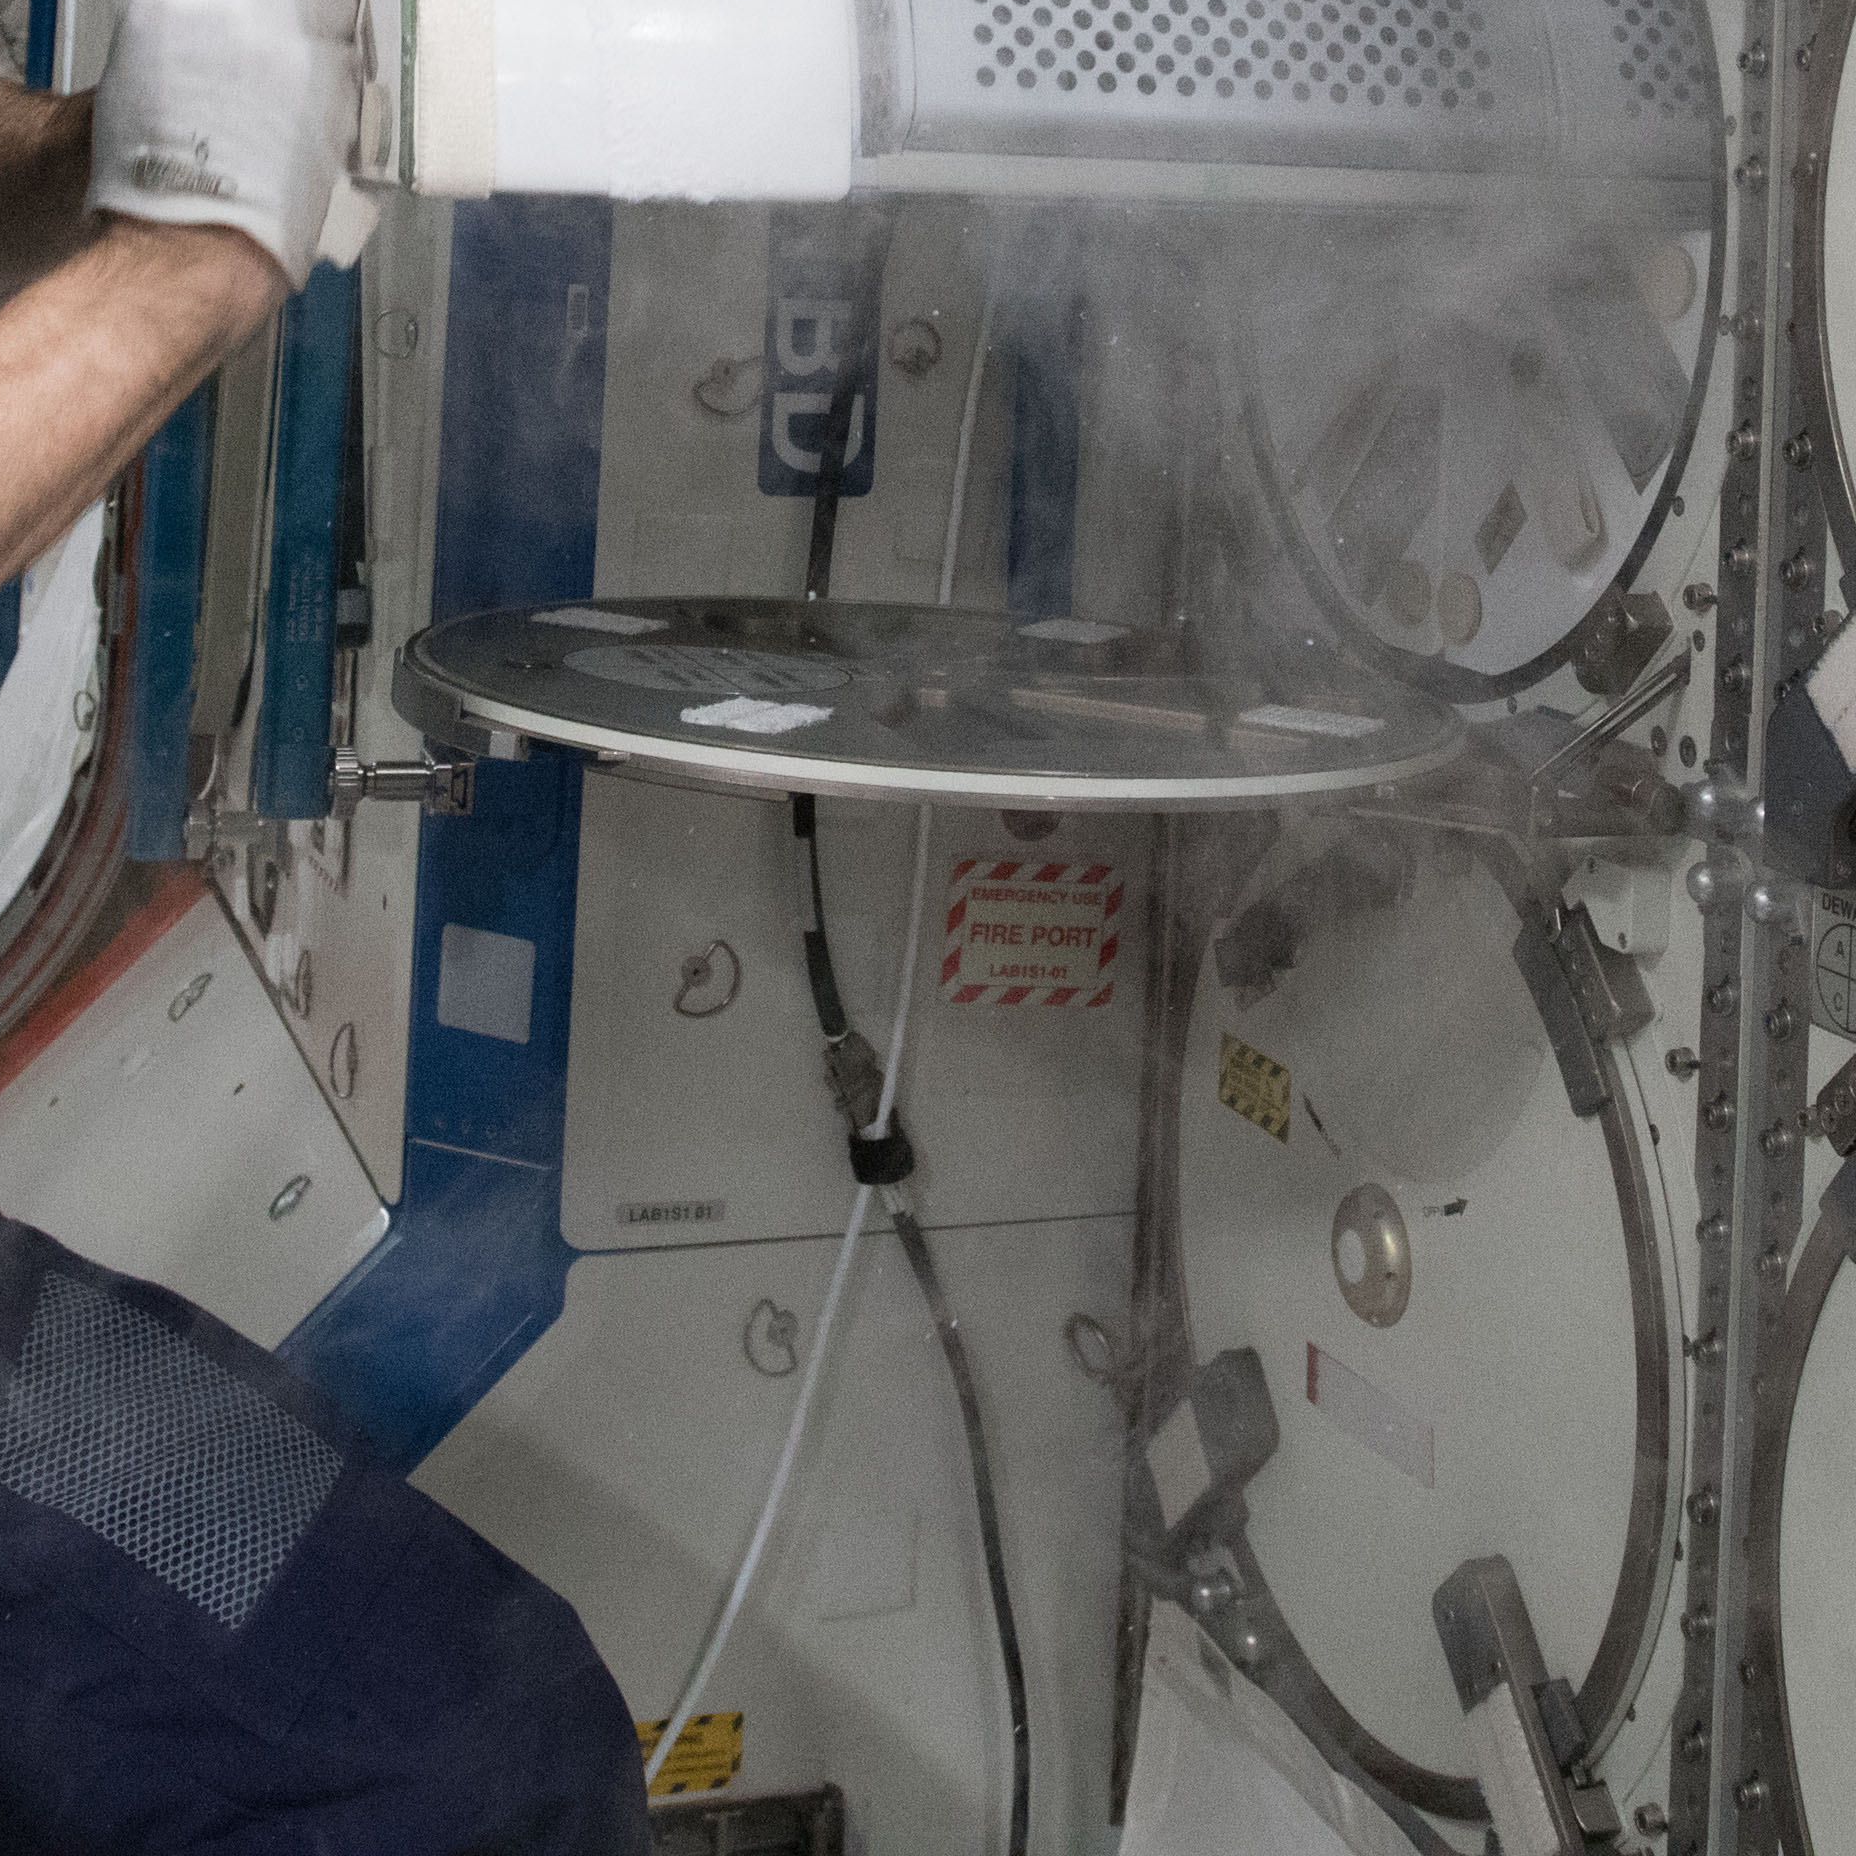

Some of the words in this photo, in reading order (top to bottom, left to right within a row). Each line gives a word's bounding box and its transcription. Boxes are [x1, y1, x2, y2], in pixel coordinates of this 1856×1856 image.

[971, 887, 1068, 905] EMERGENCY
[1071, 892, 1101, 906] USE
[970, 922, 1025, 945] FIRE
[1031, 924, 1098, 949] PORT
[1835, 940, 1844, 957] A
[1833, 991, 1844, 1012] C
